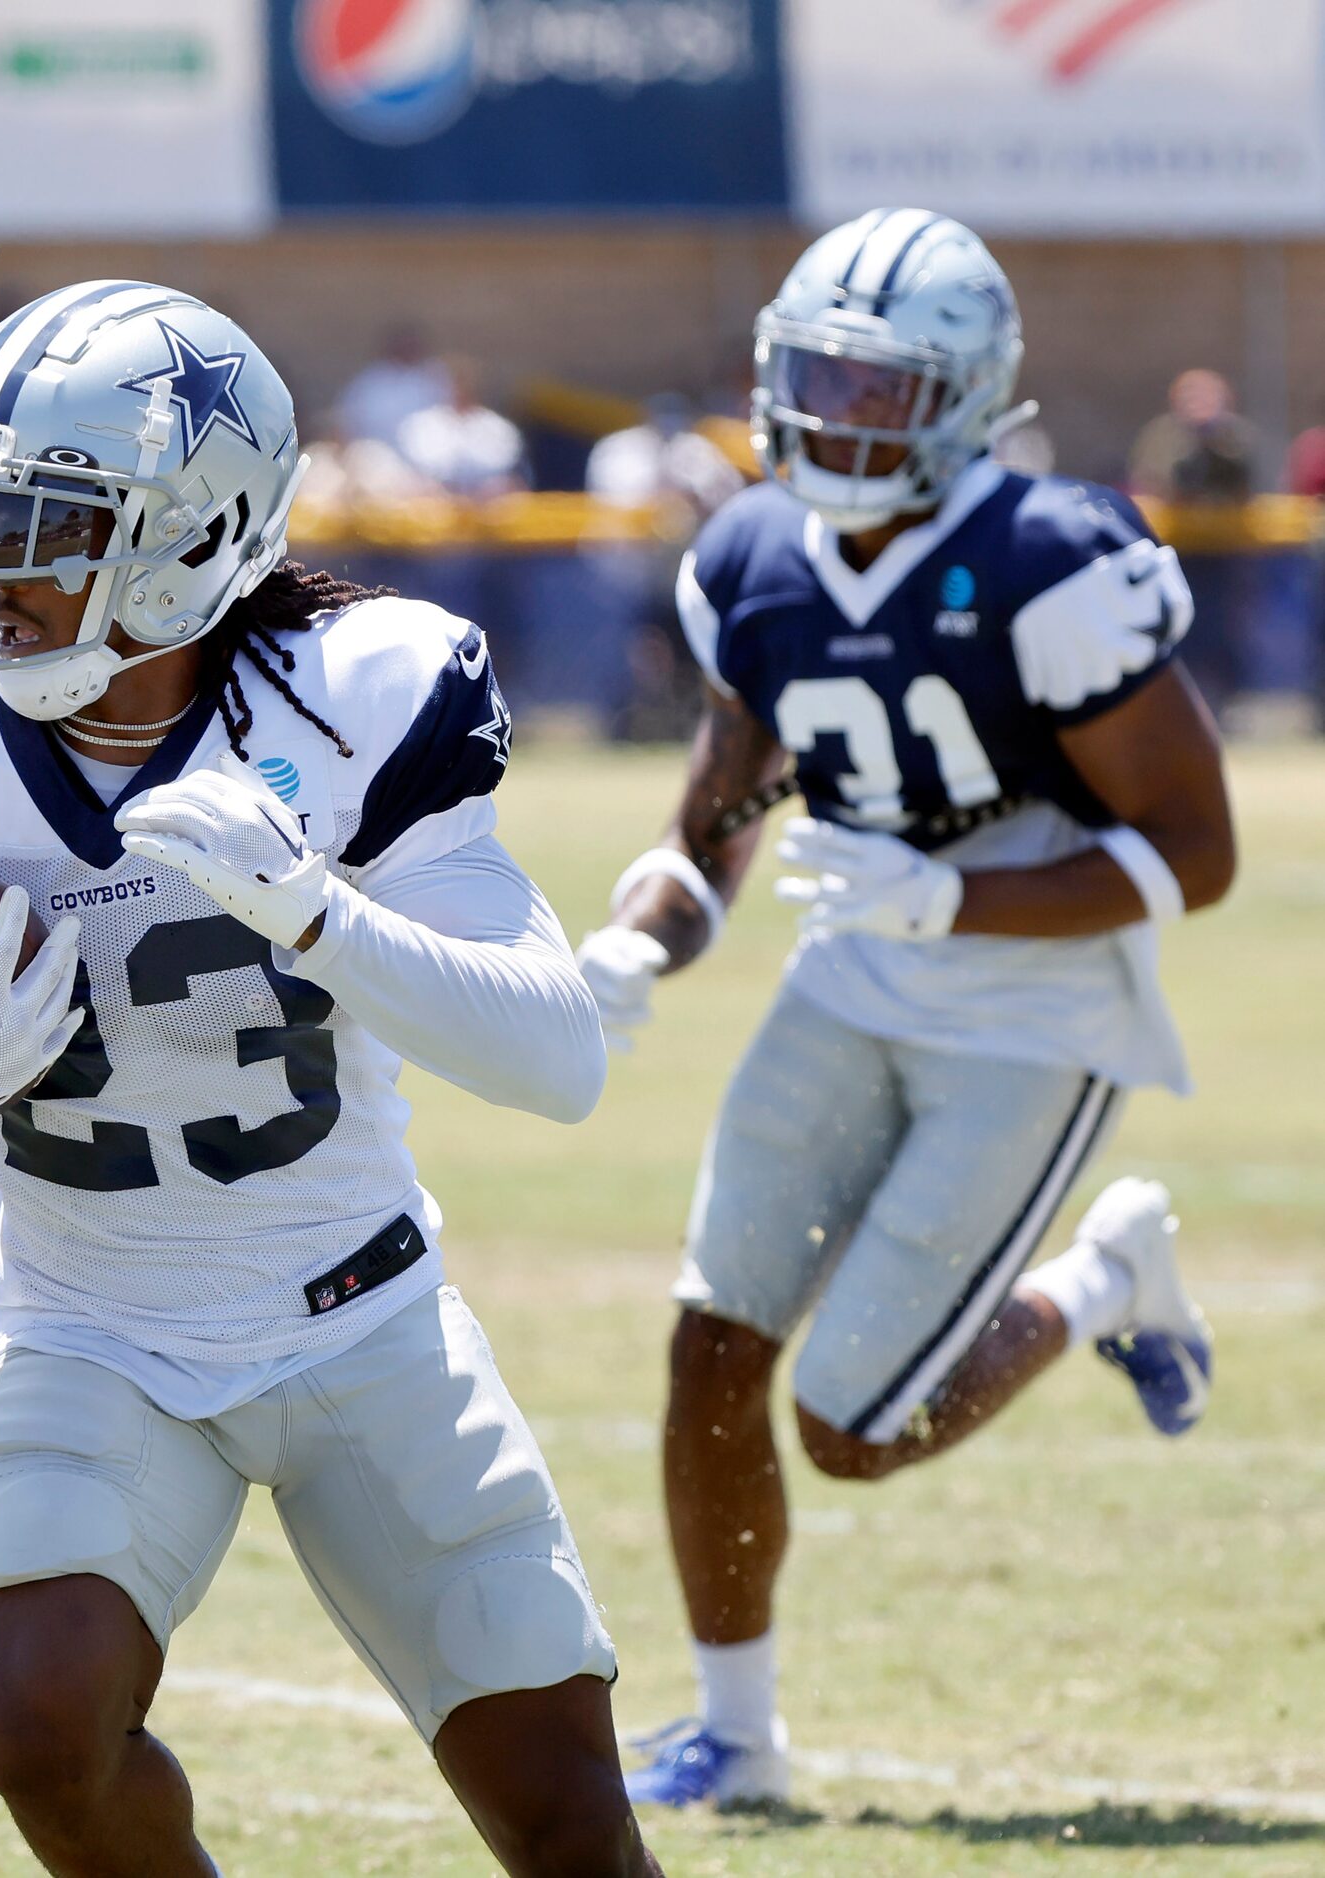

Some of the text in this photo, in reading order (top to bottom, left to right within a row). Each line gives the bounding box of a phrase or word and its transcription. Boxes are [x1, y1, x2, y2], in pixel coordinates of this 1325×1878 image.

[774, 673, 1002, 832] 31
[50, 876, 156, 911] COWBOYS
[1, 913, 341, 1192] 23
